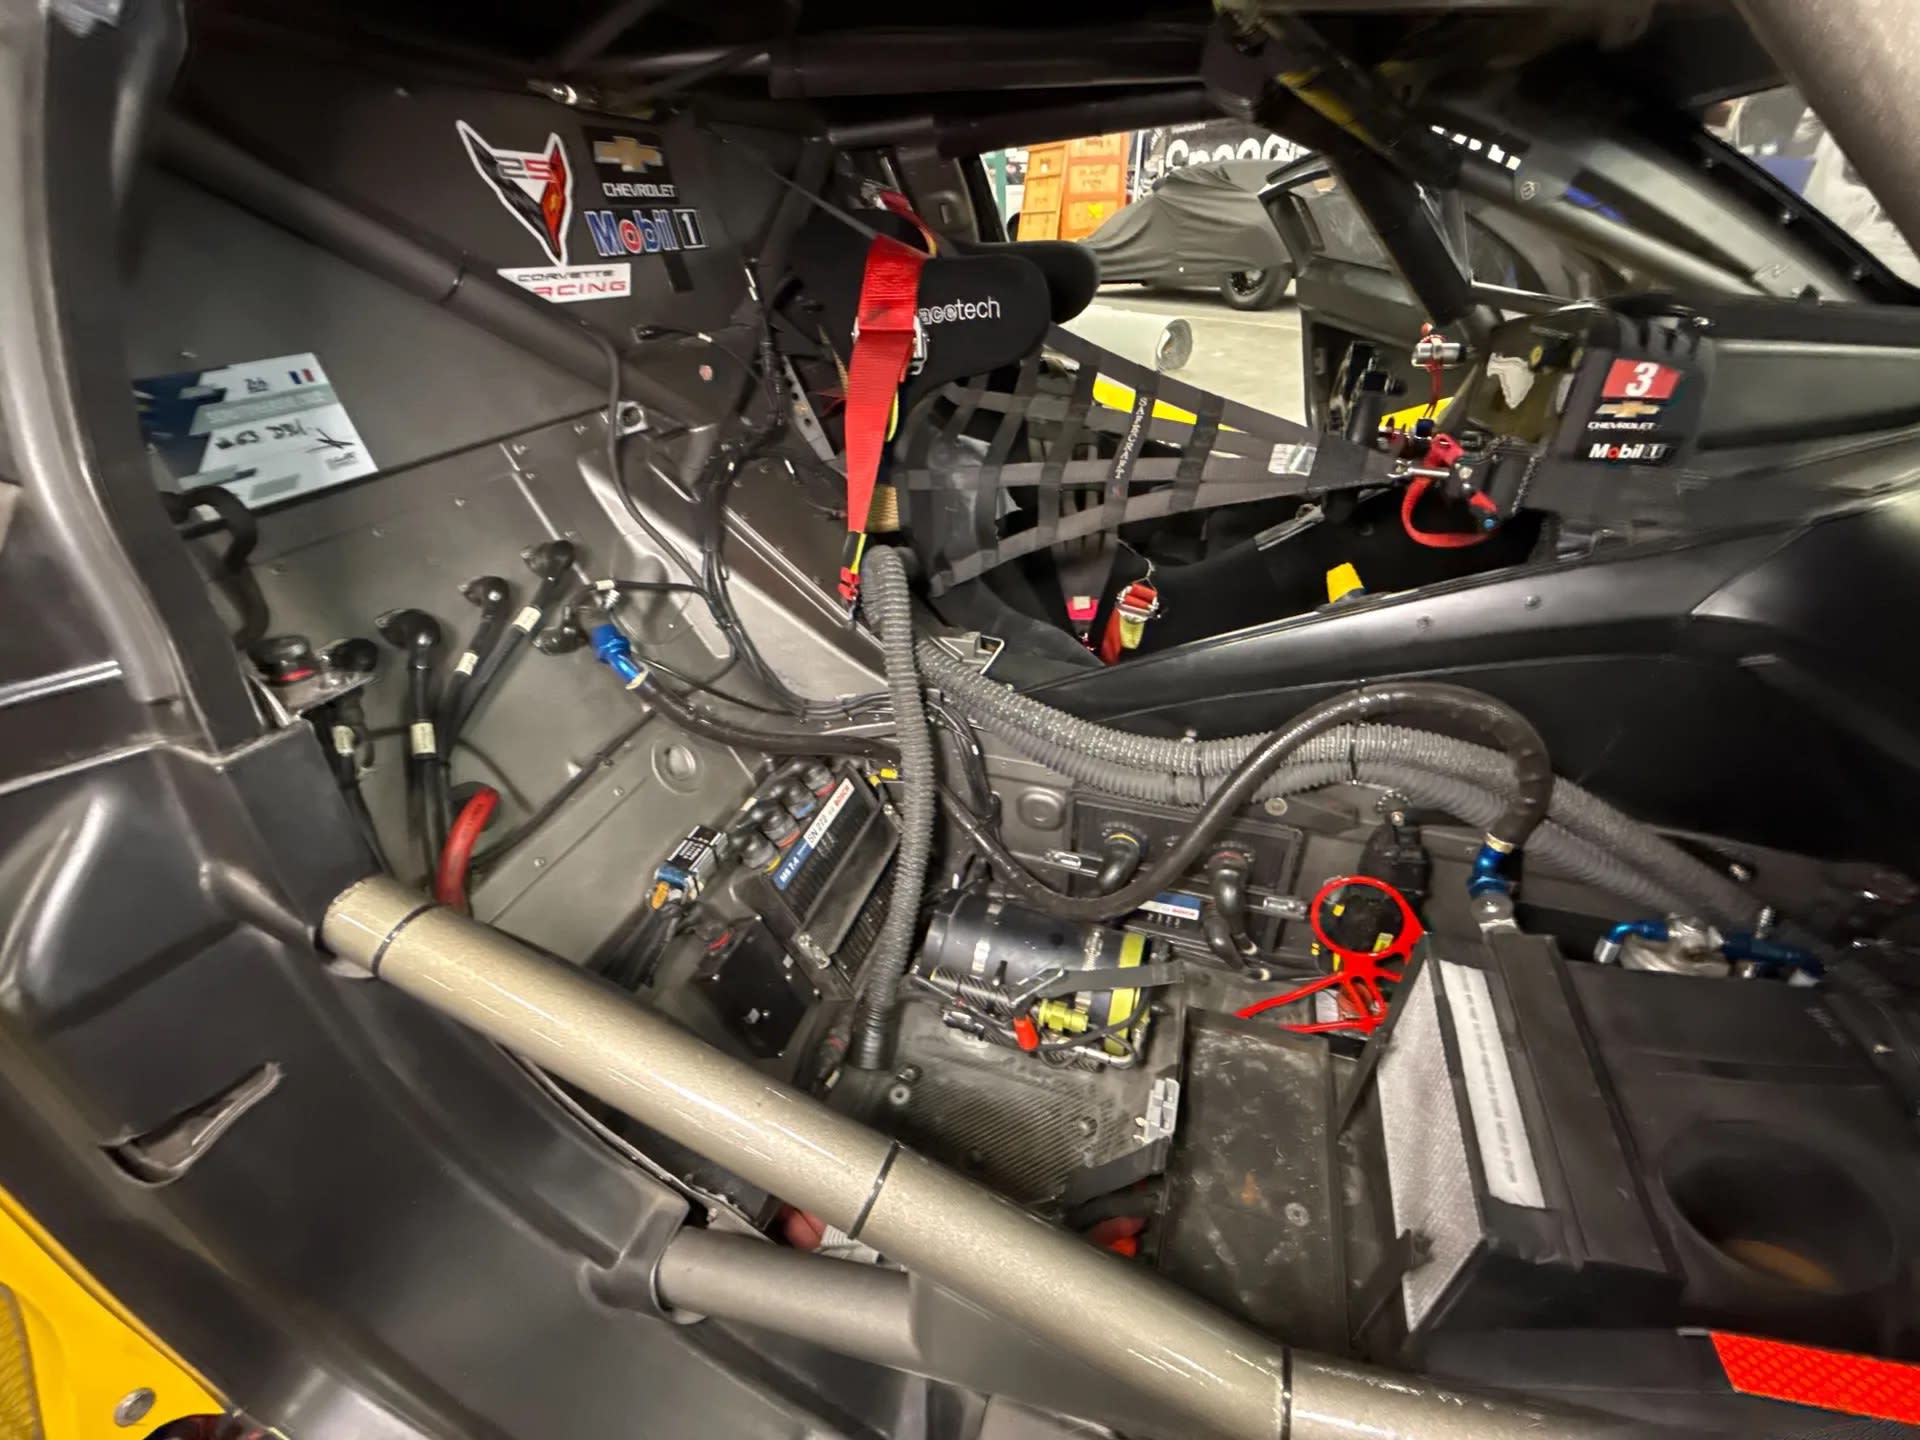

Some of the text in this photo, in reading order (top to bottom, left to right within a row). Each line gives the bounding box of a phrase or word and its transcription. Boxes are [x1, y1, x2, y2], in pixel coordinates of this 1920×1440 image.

[495, 156, 556, 183] 25
[602, 182, 677, 198] CHEVROLET
[584, 209, 680, 257] Mobil
[517, 269, 615, 282] CORVETTE
[919, 296, 1001, 325] acetech
[1625, 362, 1659, 397] 3
[1587, 422, 1655, 430] CHEVROLET
[1588, 442, 1645, 459] Mobil
